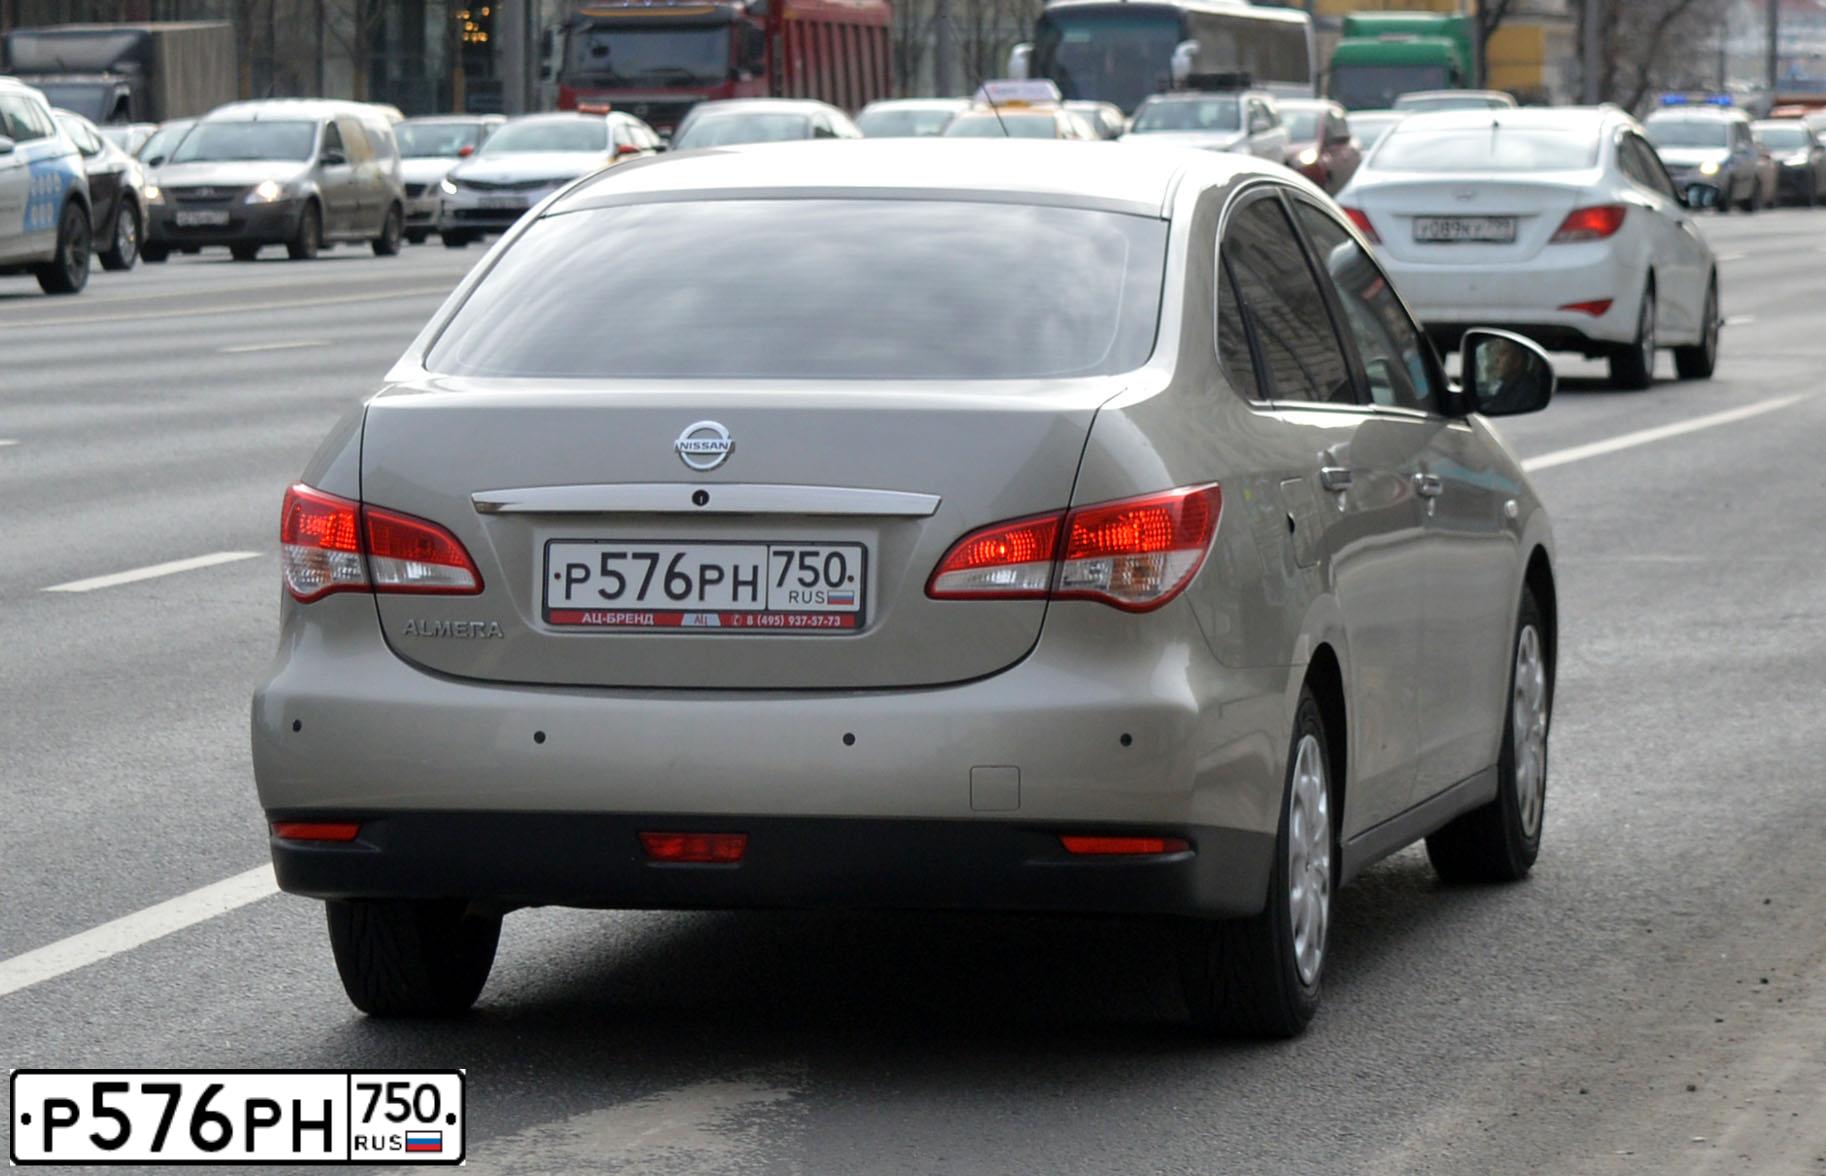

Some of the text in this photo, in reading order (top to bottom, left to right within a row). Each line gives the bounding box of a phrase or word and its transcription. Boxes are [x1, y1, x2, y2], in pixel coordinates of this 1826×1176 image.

[680, 441, 728, 449] NISSAN
[772, 550, 847, 588] 750
[788, 590, 825, 604] RUS
[582, 612, 654, 625] АЦ-БРЕНД
[757, 614, 784, 627] (495)
[788, 614, 841, 627] 937-57-73
[402, 619, 505, 639] ALMERA
